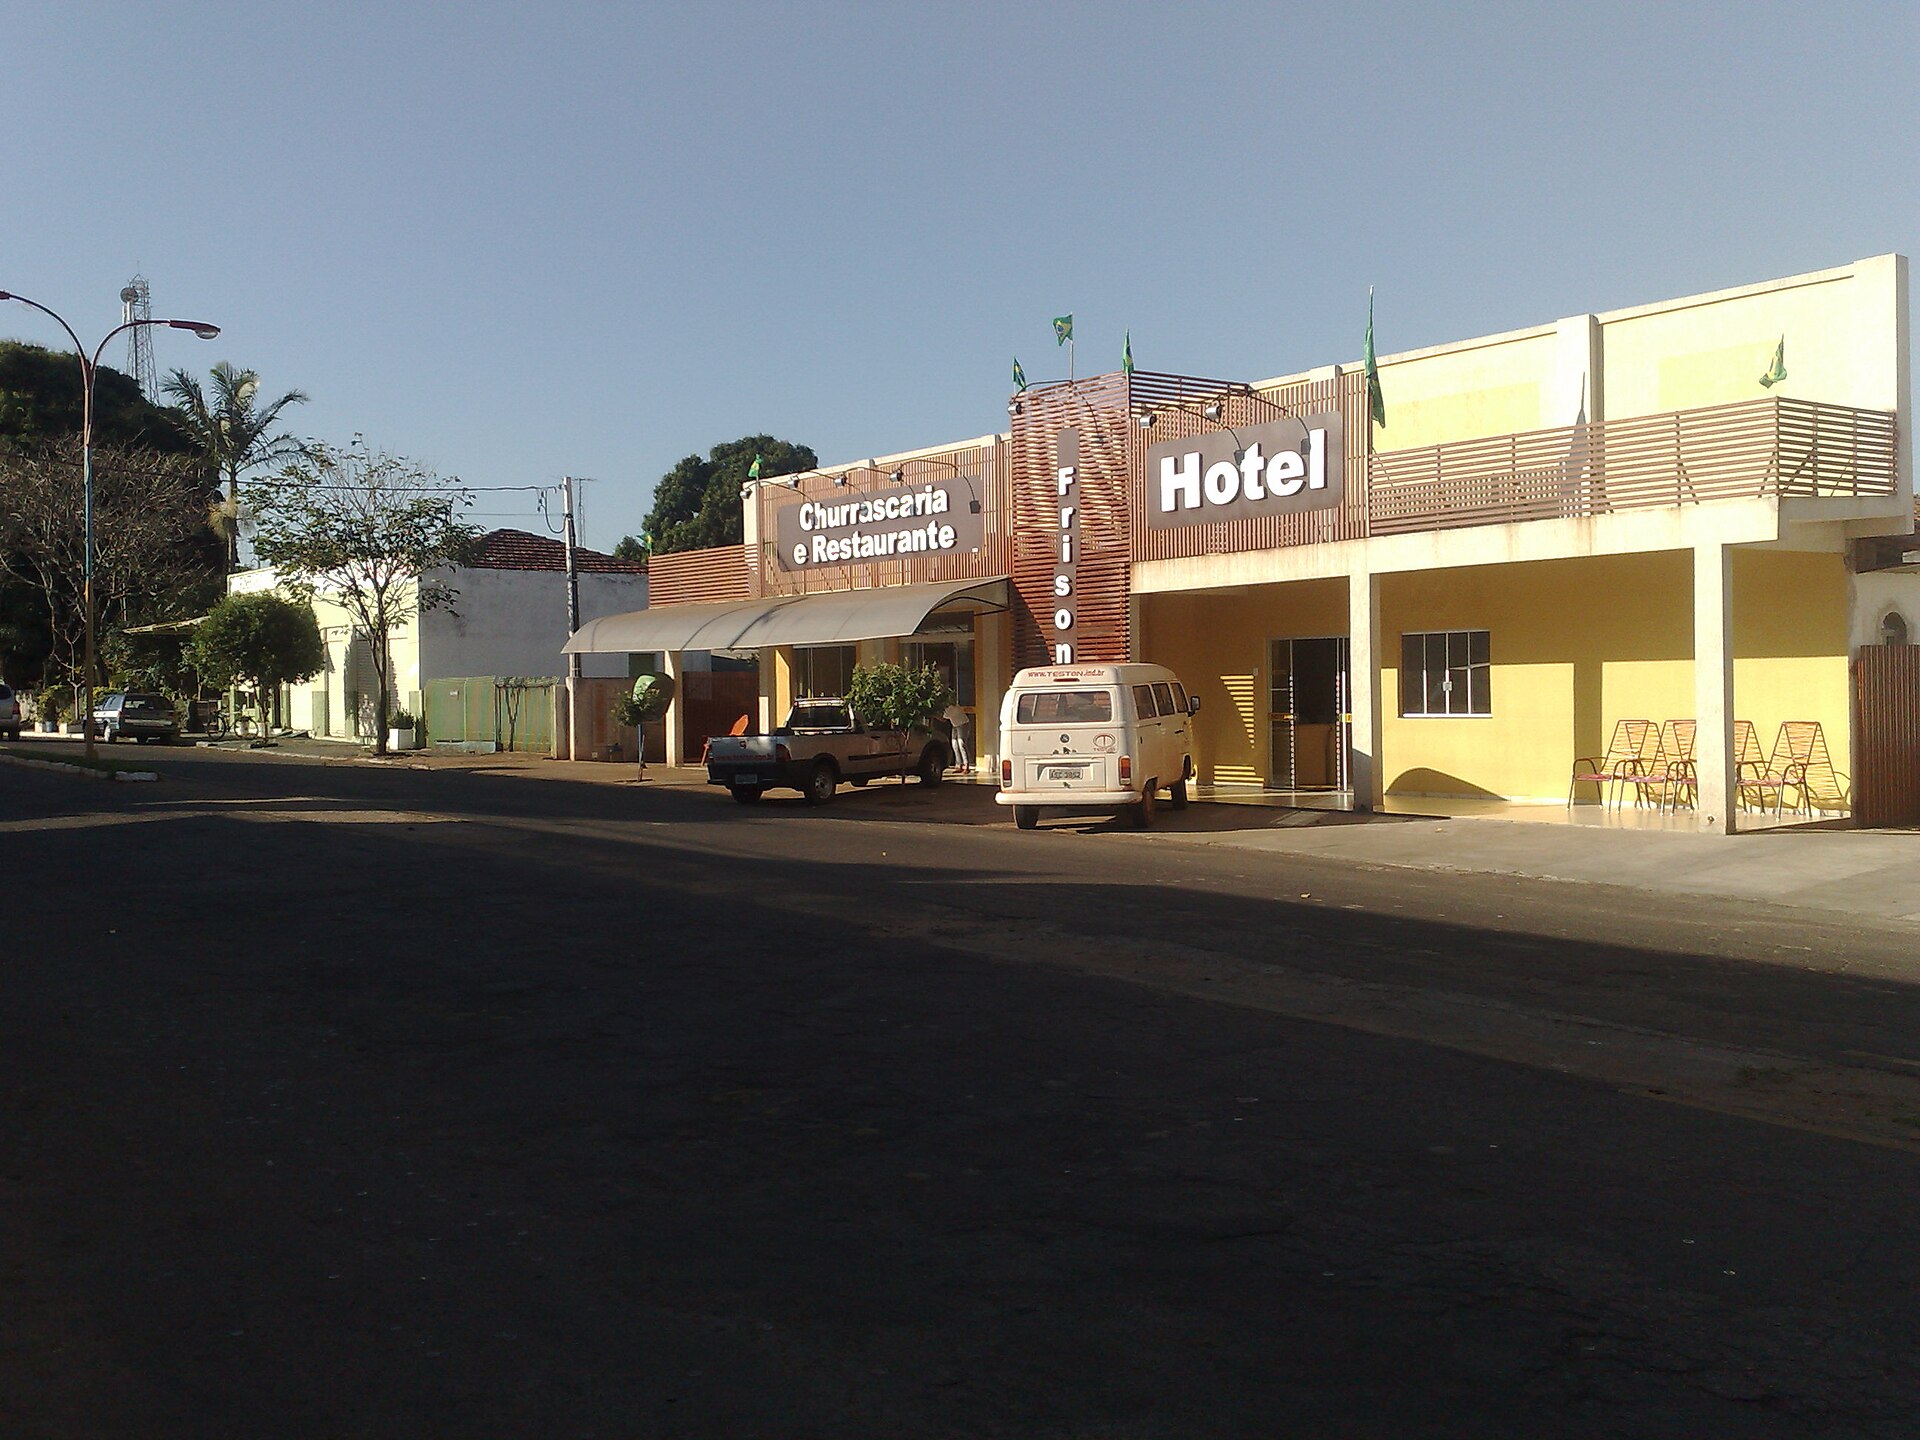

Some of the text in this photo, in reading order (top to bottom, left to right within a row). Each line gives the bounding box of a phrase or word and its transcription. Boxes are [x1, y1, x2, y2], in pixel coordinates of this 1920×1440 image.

[1160, 428, 1327, 512] Hotel
[799, 484, 949, 531] Churrascaria
[793, 520, 957, 564] e Restaurante
[1054, 466, 1076, 664] Frison
